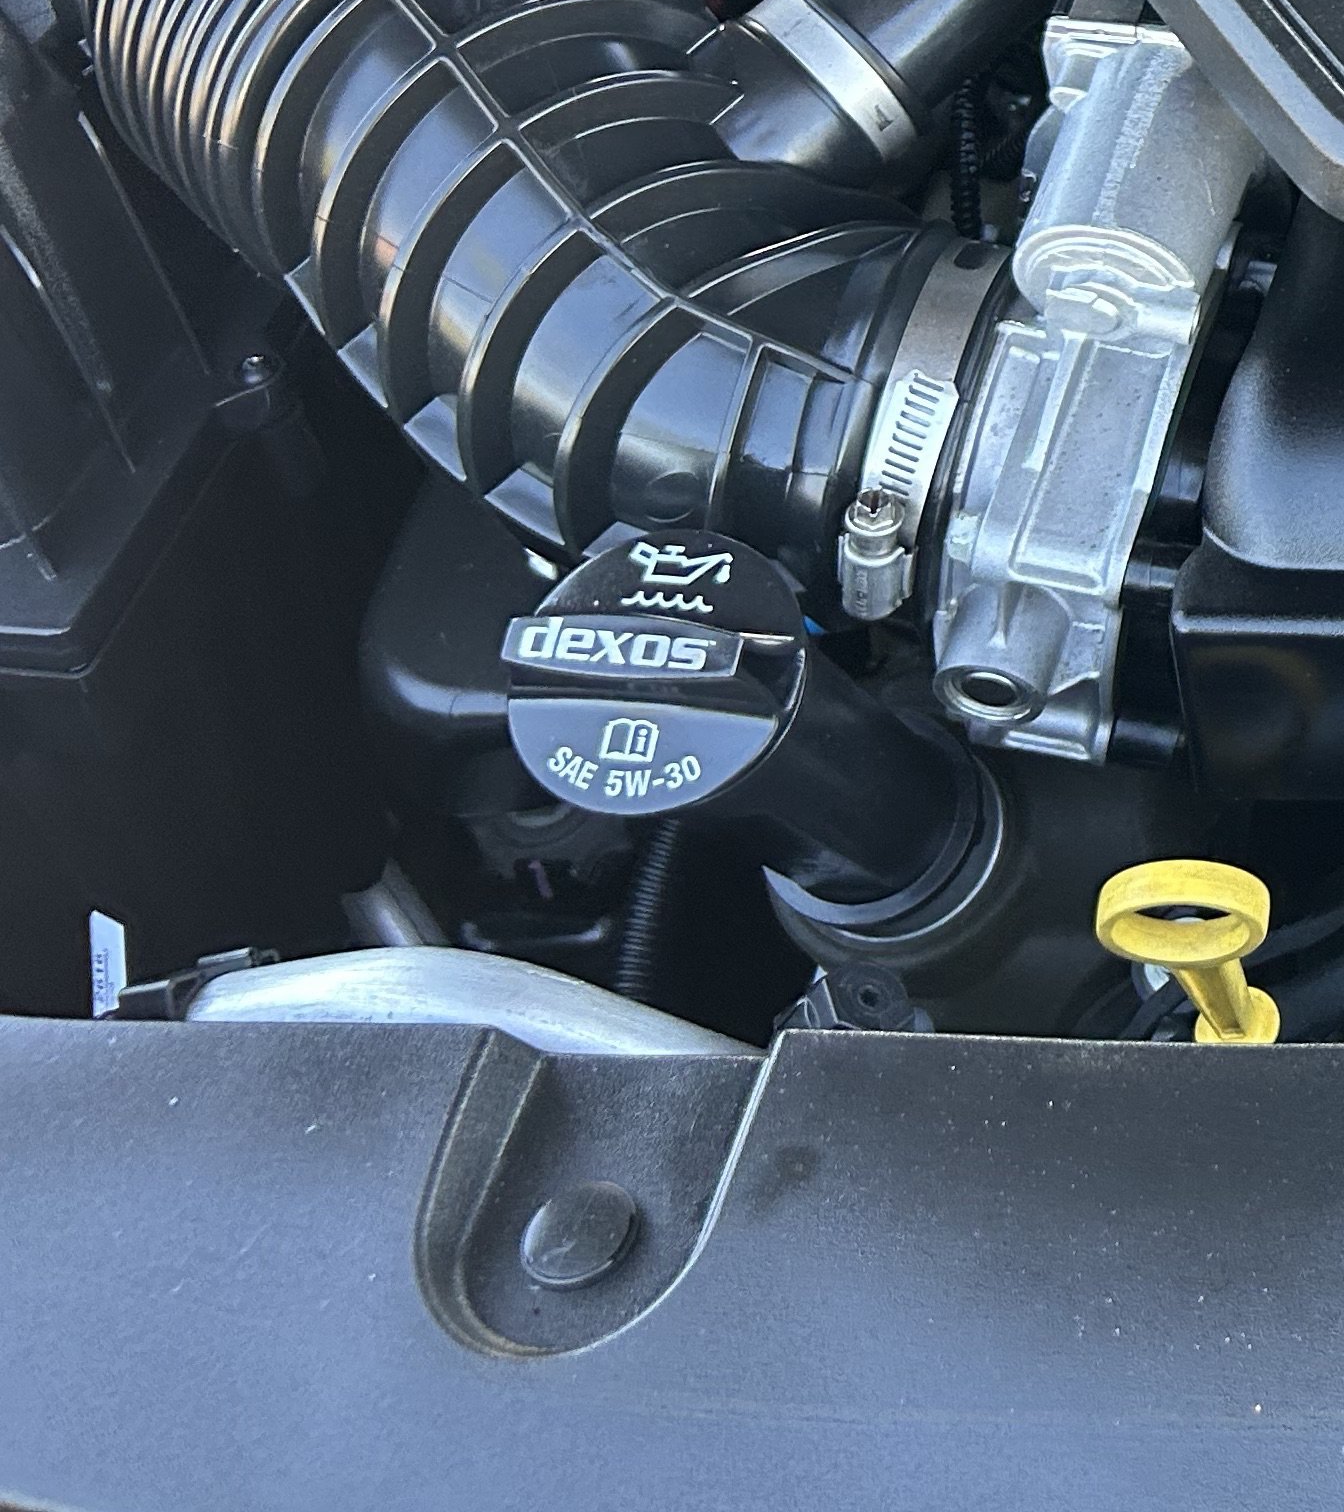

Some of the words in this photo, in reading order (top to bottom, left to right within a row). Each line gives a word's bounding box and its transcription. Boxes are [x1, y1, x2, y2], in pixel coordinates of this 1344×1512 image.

[517, 616, 710, 671] dexos
[549, 746, 599, 790] SAE
[604, 755, 702, 798] 5W-30
